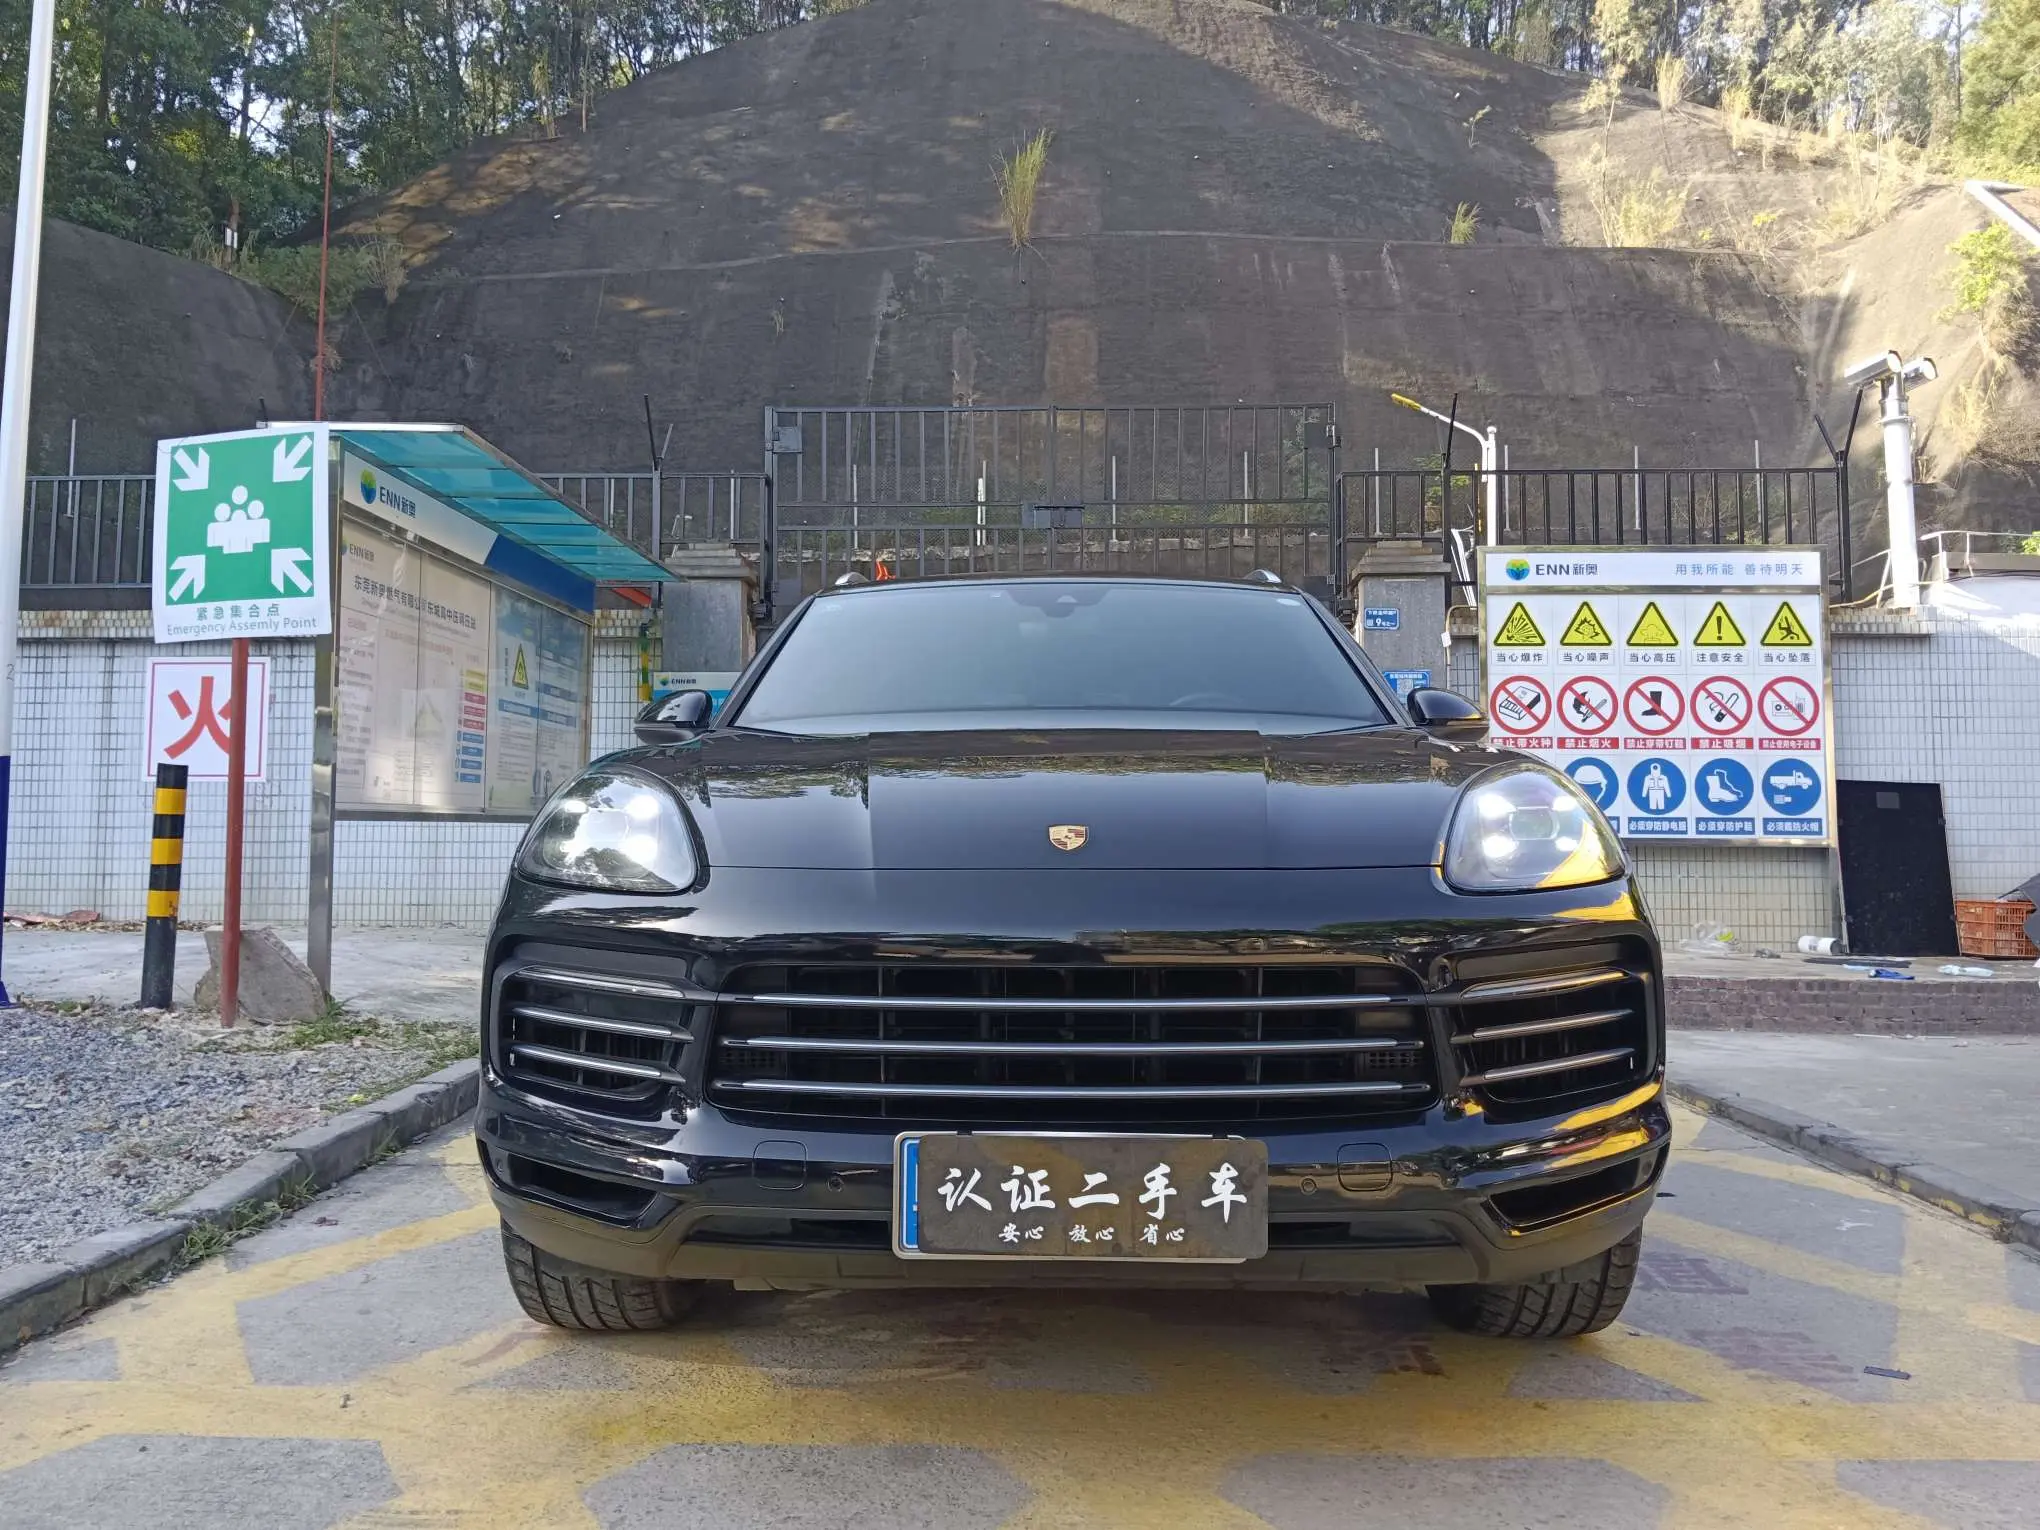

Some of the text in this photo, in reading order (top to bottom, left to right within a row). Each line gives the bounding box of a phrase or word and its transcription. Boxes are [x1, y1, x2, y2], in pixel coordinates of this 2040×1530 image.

[379, 486, 417, 518] ENN新奥
[1535, 563, 1598, 576] ENN新奥
[1675, 563, 1804, 576] 用我所能 善待明天
[196, 603, 280, 621] 紧急集合点
[167, 616, 317, 637] Emergency Assemly Point
[1496, 653, 1543, 663] 当心爆炸
[1563, 653, 1609, 663] 当心噪声
[1629, 653, 1676, 663] 当心高压
[1696, 653, 1744, 663] 注意安全
[1763, 653, 1811, 663] 当心坠落
[163, 676, 233, 760] 火
[1564, 738, 1612, 748] 禁止烟火
[1698, 738, 1747, 749] 禁止吸烟
[937, 1162, 1247, 1223] 认证二手车
[998, 1222, 1185, 1245] 安心 放心 省心
